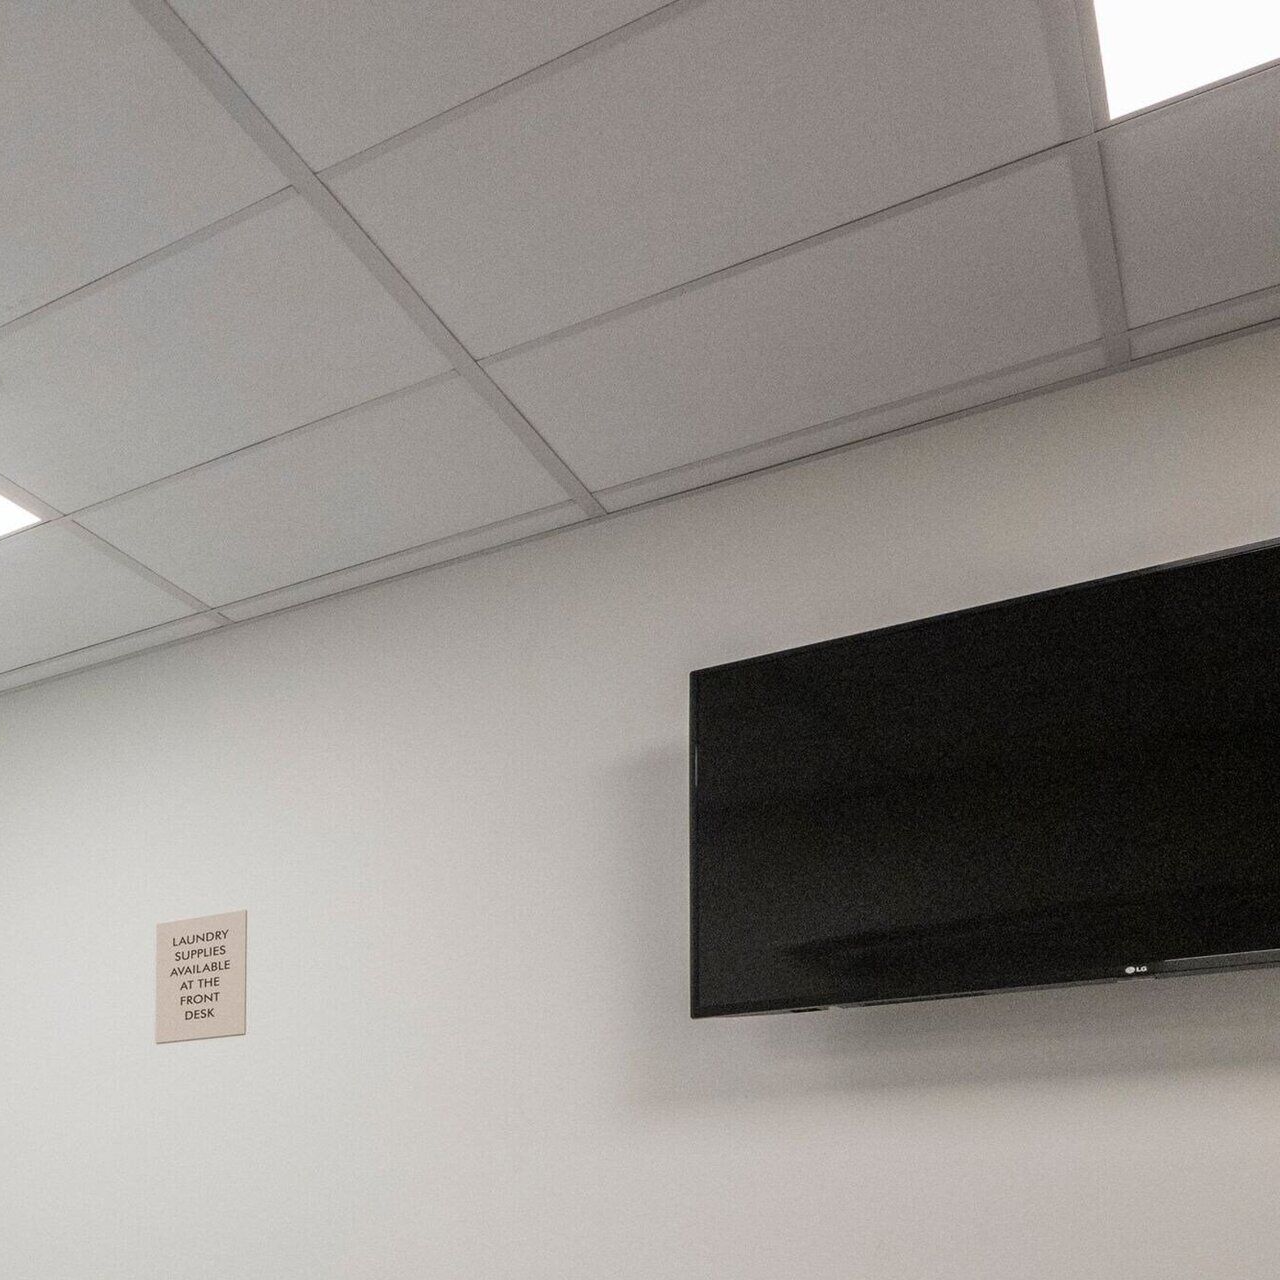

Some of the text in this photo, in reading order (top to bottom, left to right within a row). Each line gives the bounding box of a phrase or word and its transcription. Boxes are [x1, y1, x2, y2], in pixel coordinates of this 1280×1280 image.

[172, 929, 229, 947] LAUNDRY
[175, 945, 226, 961] SUPPLIES
[170, 960, 230, 977] AVAILABLE
[180, 977, 220, 990] AT THE
[180, 992, 220, 1005] FRONT
[185, 1008, 215, 1020] DESK
